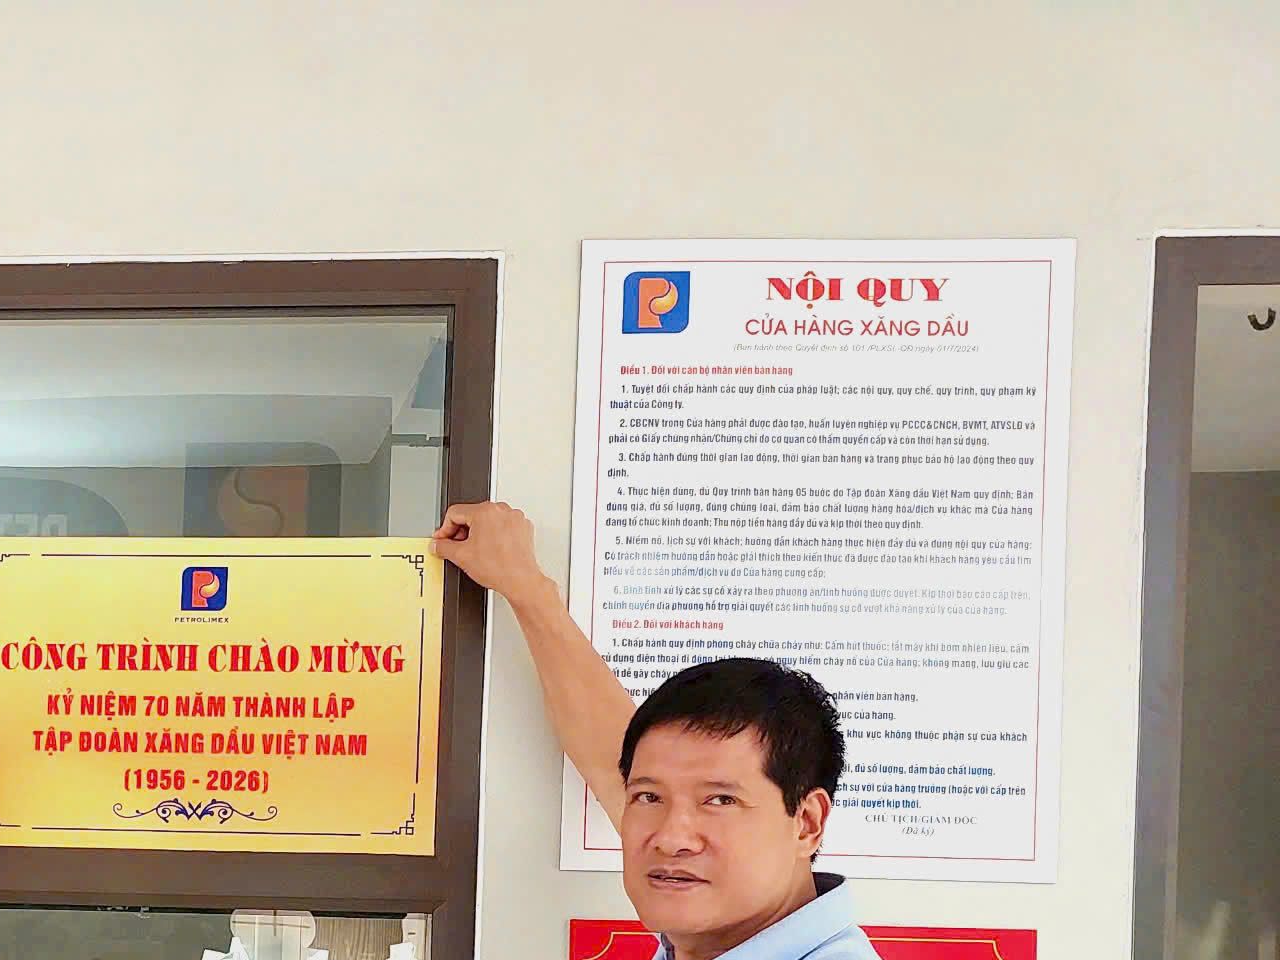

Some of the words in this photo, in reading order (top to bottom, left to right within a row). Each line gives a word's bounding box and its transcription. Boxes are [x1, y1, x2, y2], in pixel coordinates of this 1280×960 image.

[766, 271, 844, 309] NỘI
[857, 278, 950, 307] QUY
[745, 313, 787, 336] CỬA
[794, 316, 853, 336] HÀNG
[860, 316, 920, 336] XĂNG
[928, 314, 968, 336] DẦU
[1, 636, 87, 672] CÔNG
[97, 637, 198, 672] TRÌNH
[209, 638, 299, 673] CHÀO
[308, 638, 405, 674] MỪNG
[48, 688, 74, 716] KỶ
[80, 690, 136, 722] NIỆM
[144, 697, 168, 716] 70
[176, 691, 225, 717] NĂM
[232, 691, 306, 718] THÀNH
[313, 693, 355, 722] LẬP
[33, 726, 72, 757] TẬP
[79, 727, 138, 753] ĐOÀN
[144, 729, 203, 754] XĂNG
[210, 724, 255, 755] DẦU
[262, 729, 310, 760] VIỆT
[316, 735, 367, 755] NAM
[124, 769, 185, 791] (1956
[207, 770, 269, 793] 2026)
